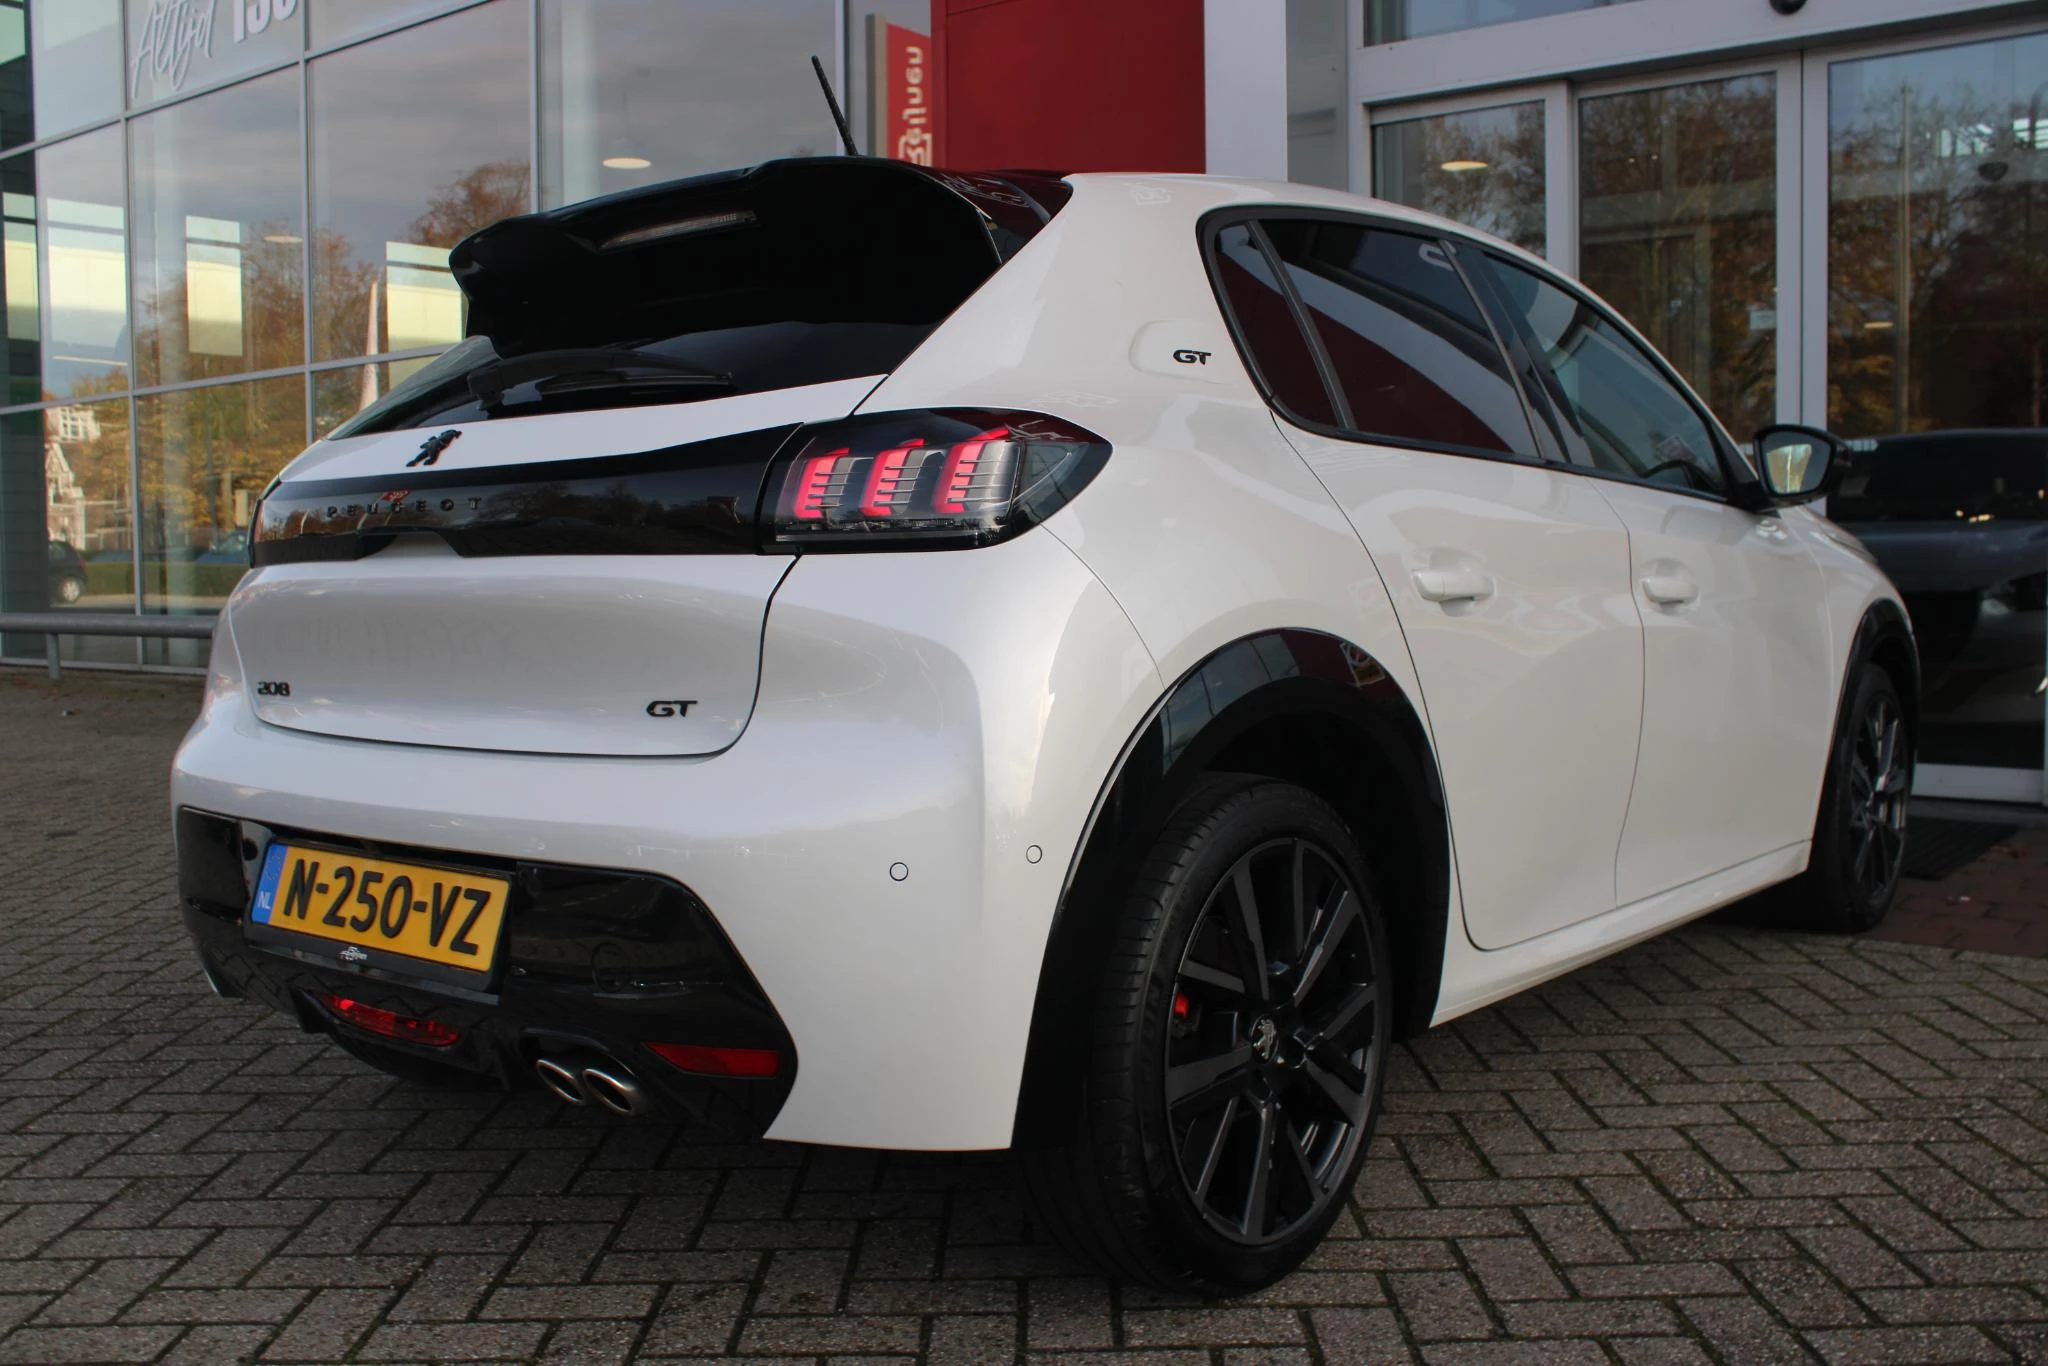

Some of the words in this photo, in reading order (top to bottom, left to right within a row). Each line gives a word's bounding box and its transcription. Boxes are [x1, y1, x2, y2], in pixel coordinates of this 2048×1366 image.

[1172, 349, 1212, 366] GT
[327, 497, 482, 518] PEUGEOT
[257, 680, 291, 697] 208
[646, 700, 698, 717] GT
[257, 891, 271, 910] NL
[283, 858, 491, 956] N-250-VZ
